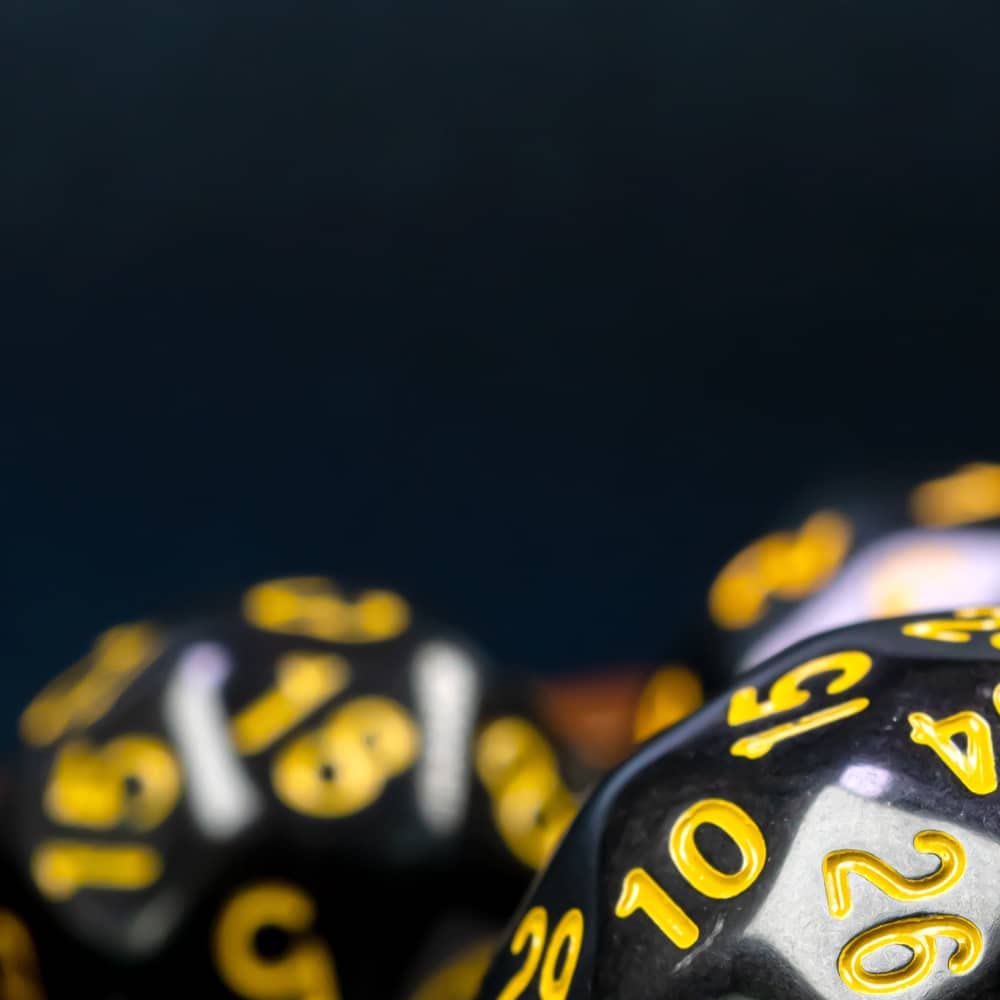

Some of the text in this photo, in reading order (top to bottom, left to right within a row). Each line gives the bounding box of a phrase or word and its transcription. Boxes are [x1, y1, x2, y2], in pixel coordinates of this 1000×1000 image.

[726, 650, 872, 760] 15
[614, 797, 767, 950] 10
[822, 829, 984, 994] 26
